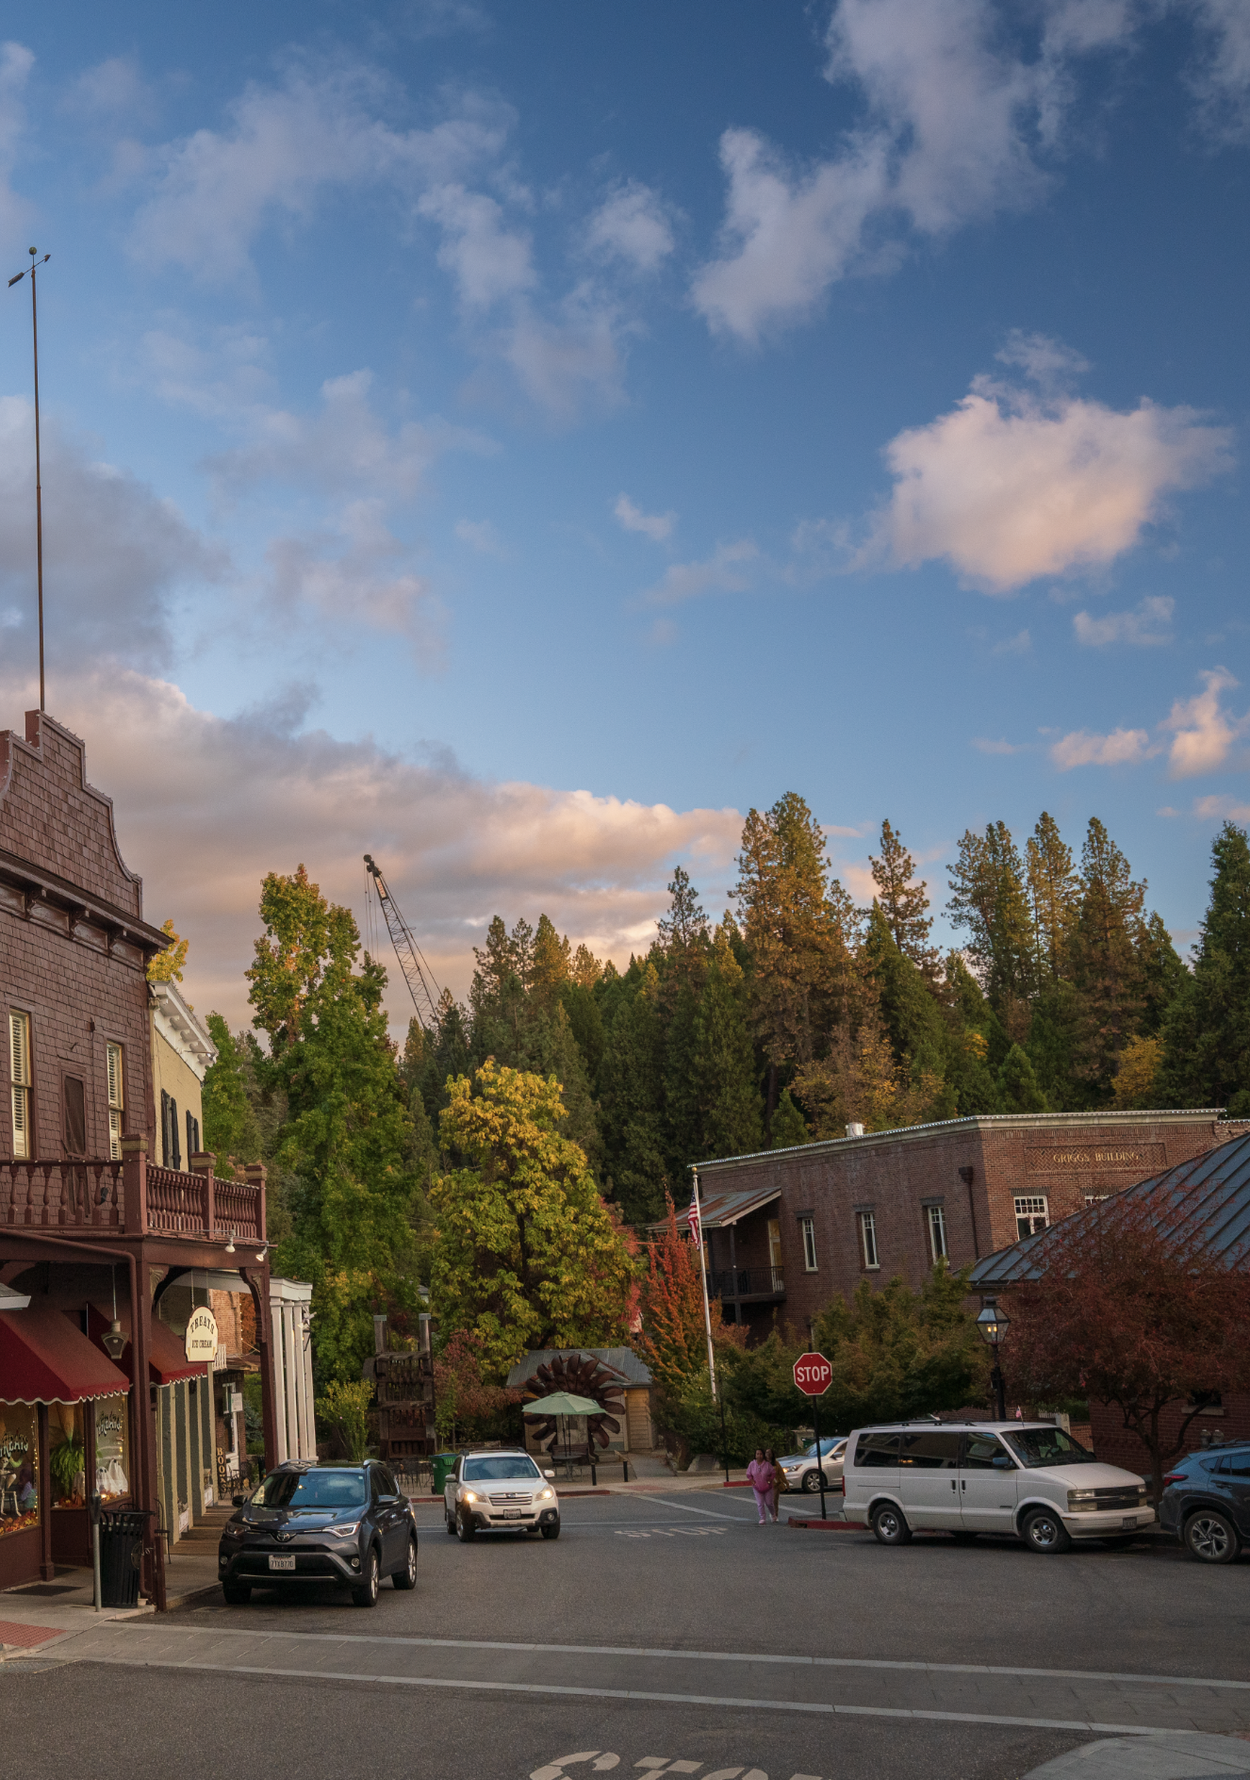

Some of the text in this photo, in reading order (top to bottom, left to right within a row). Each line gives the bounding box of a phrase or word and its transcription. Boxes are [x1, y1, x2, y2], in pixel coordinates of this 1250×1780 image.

[1053, 1152, 1139, 1163] GRIGGS BUILDING
[190, 1315, 214, 1335] TREATS
[199, 1340, 212, 1348] CREAM
[796, 1366, 829, 1382] STOP
[614, 1526, 728, 1538] STOP
